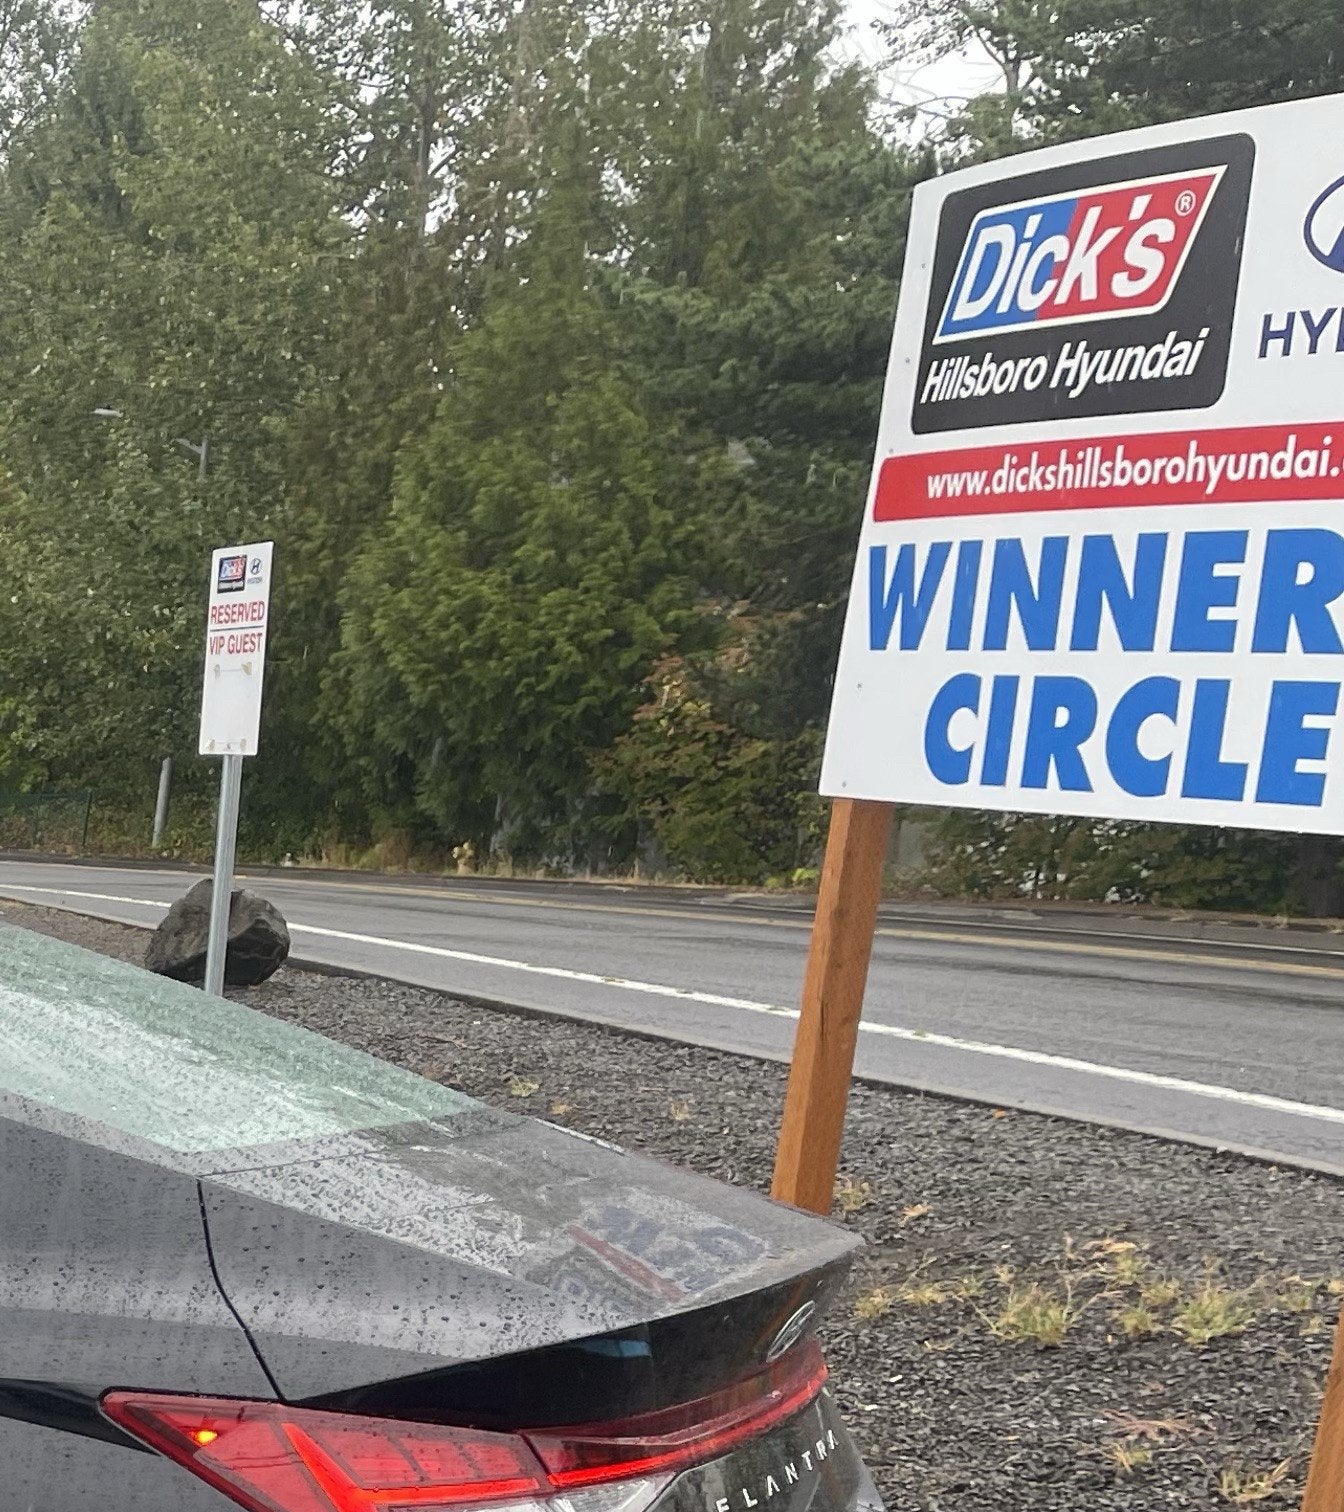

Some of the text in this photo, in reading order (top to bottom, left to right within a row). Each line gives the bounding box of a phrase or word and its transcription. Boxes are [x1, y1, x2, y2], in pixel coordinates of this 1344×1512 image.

[951, 194, 1175, 321] Dick's
[920, 327, 1210, 404] Hillsboro Hyundai
[1258, 307, 1344, 358] HY
[927, 434, 1344, 499] www.dickshillsborohyundai.
[211, 601, 265, 625] RESERVED
[869, 528, 1344, 653] WINNER
[210, 633, 262, 655] VIP GUEST
[924, 671, 1341, 807] CIRCLE
